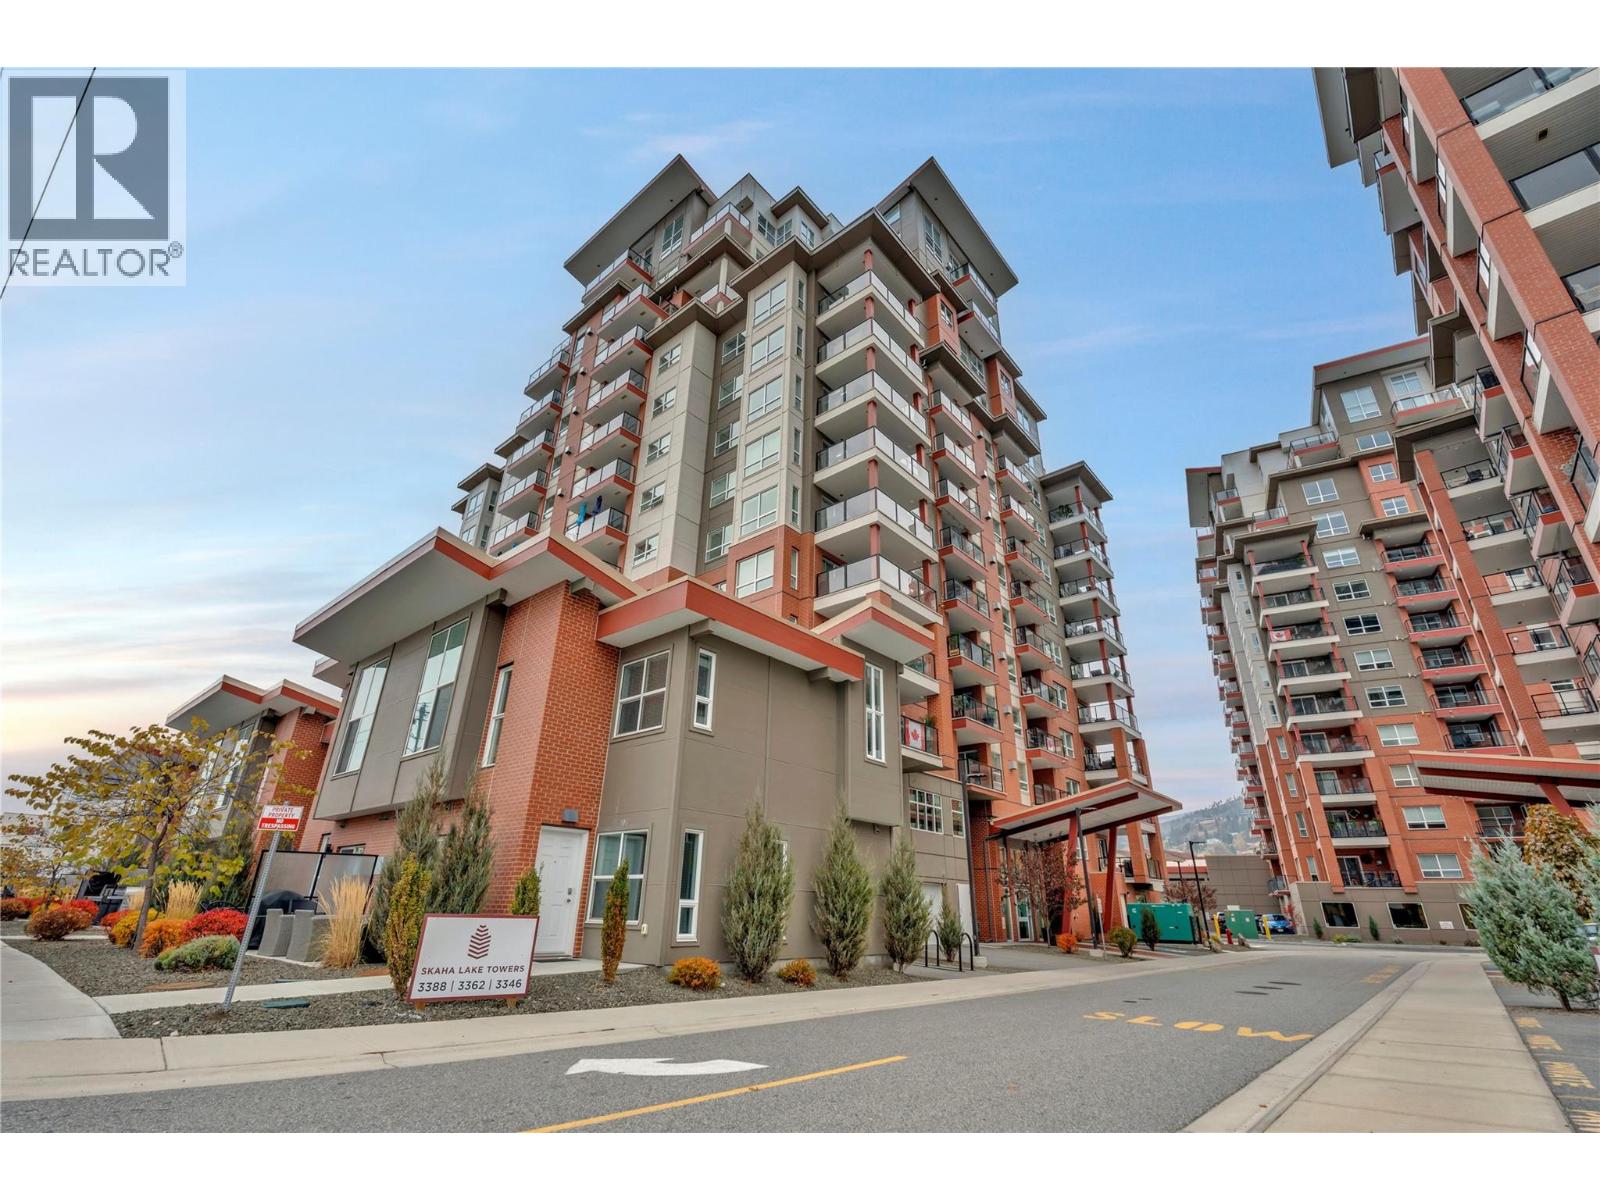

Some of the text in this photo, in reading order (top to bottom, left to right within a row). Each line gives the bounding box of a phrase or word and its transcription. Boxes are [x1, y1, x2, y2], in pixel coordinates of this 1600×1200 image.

[421, 965, 525, 975] SKAHA LAKE TOWERS
[417, 979, 522, 992] 3388 3362 3346
[1083, 1011, 1314, 1042] SLOW
